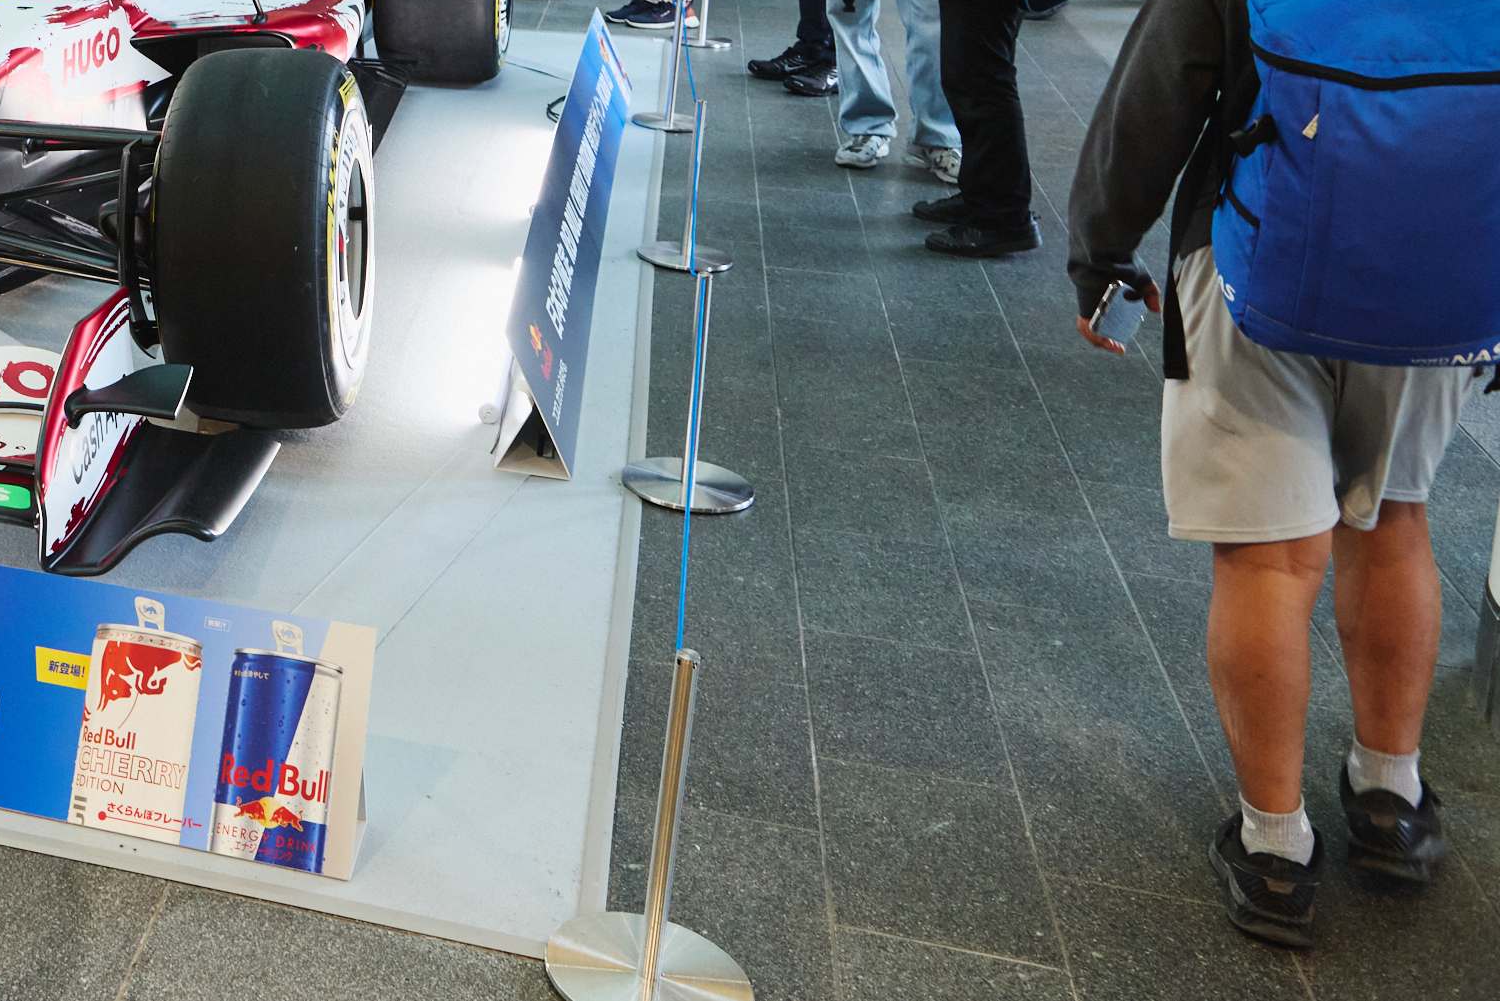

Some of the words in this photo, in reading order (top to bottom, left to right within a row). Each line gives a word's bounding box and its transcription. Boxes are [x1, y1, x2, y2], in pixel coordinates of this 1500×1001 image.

[63, 26, 121, 86] HUGO
[83, 725, 103, 745] Red
[104, 728, 137, 750] Bull
[79, 745, 187, 790] CHERRY
[221, 752, 275, 793] Red
[278, 763, 329, 804] Bull
[76, 773, 125, 795] EDITION
[106, 801, 203, 828] さくらんぼフレーバー
[215, 822, 269, 843] ENERGY
